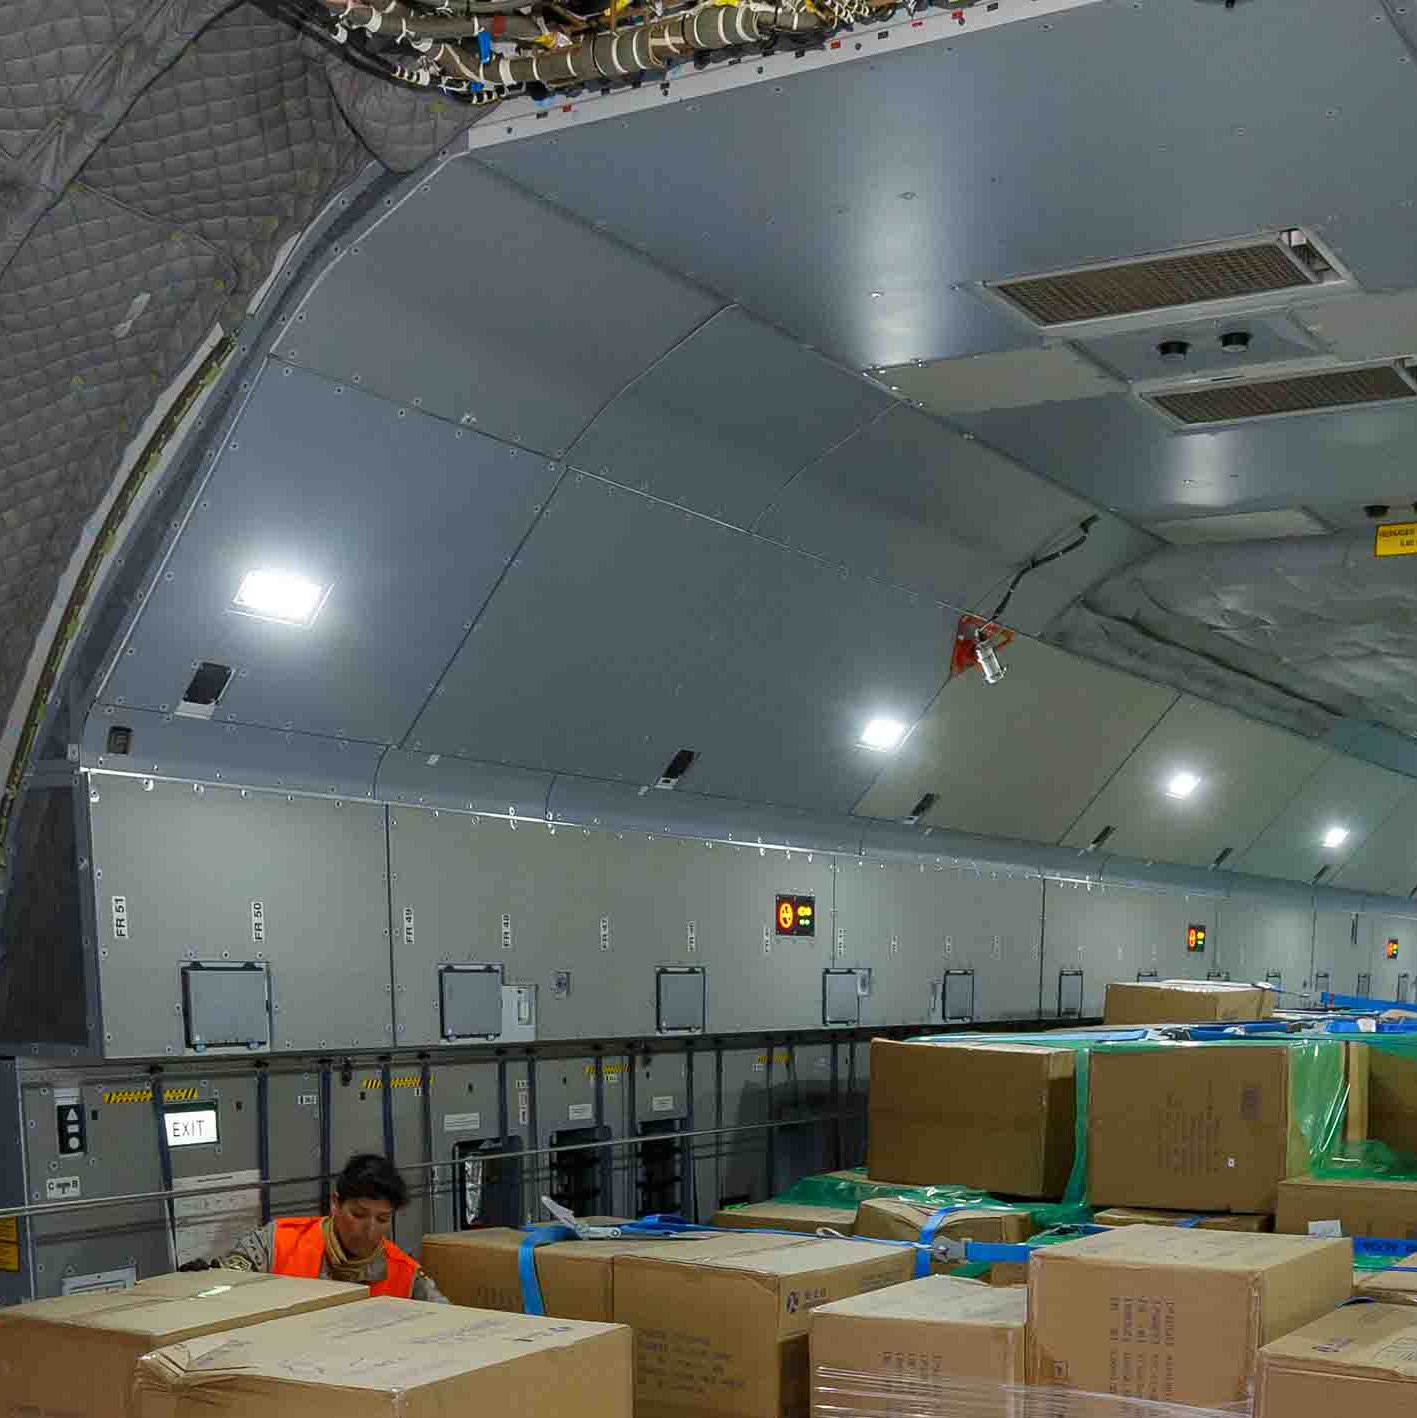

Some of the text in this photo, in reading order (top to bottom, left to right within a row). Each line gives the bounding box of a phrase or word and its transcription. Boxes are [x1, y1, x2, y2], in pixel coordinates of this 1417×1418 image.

[114, 896, 127, 938] FR 51
[253, 902, 263, 941] FR 50
[172, 1119, 206, 1138] EXIT
